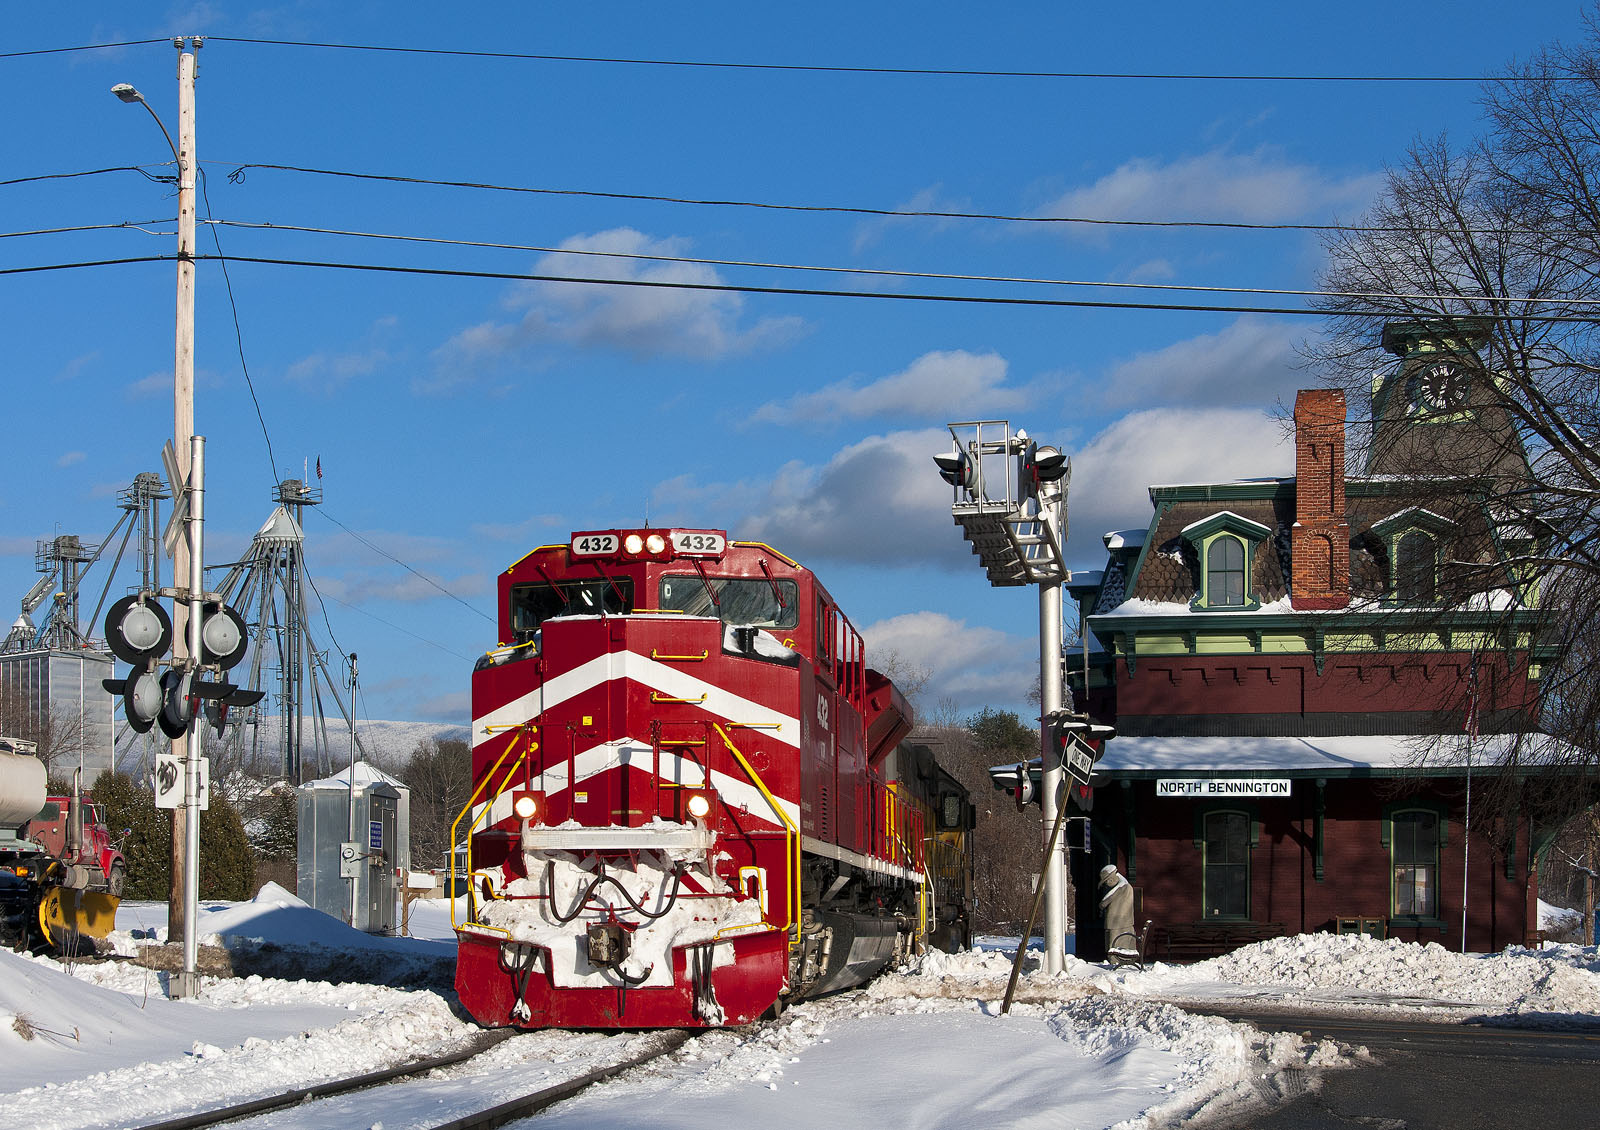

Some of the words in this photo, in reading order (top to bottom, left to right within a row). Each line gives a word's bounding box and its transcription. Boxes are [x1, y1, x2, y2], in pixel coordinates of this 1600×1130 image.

[579, 537, 613, 552] 432
[680, 535, 717, 550] 432
[817, 693, 828, 731] 432
[1160, 782, 1202, 793] NORTH
[1208, 782, 1288, 793] BENNINGTON
